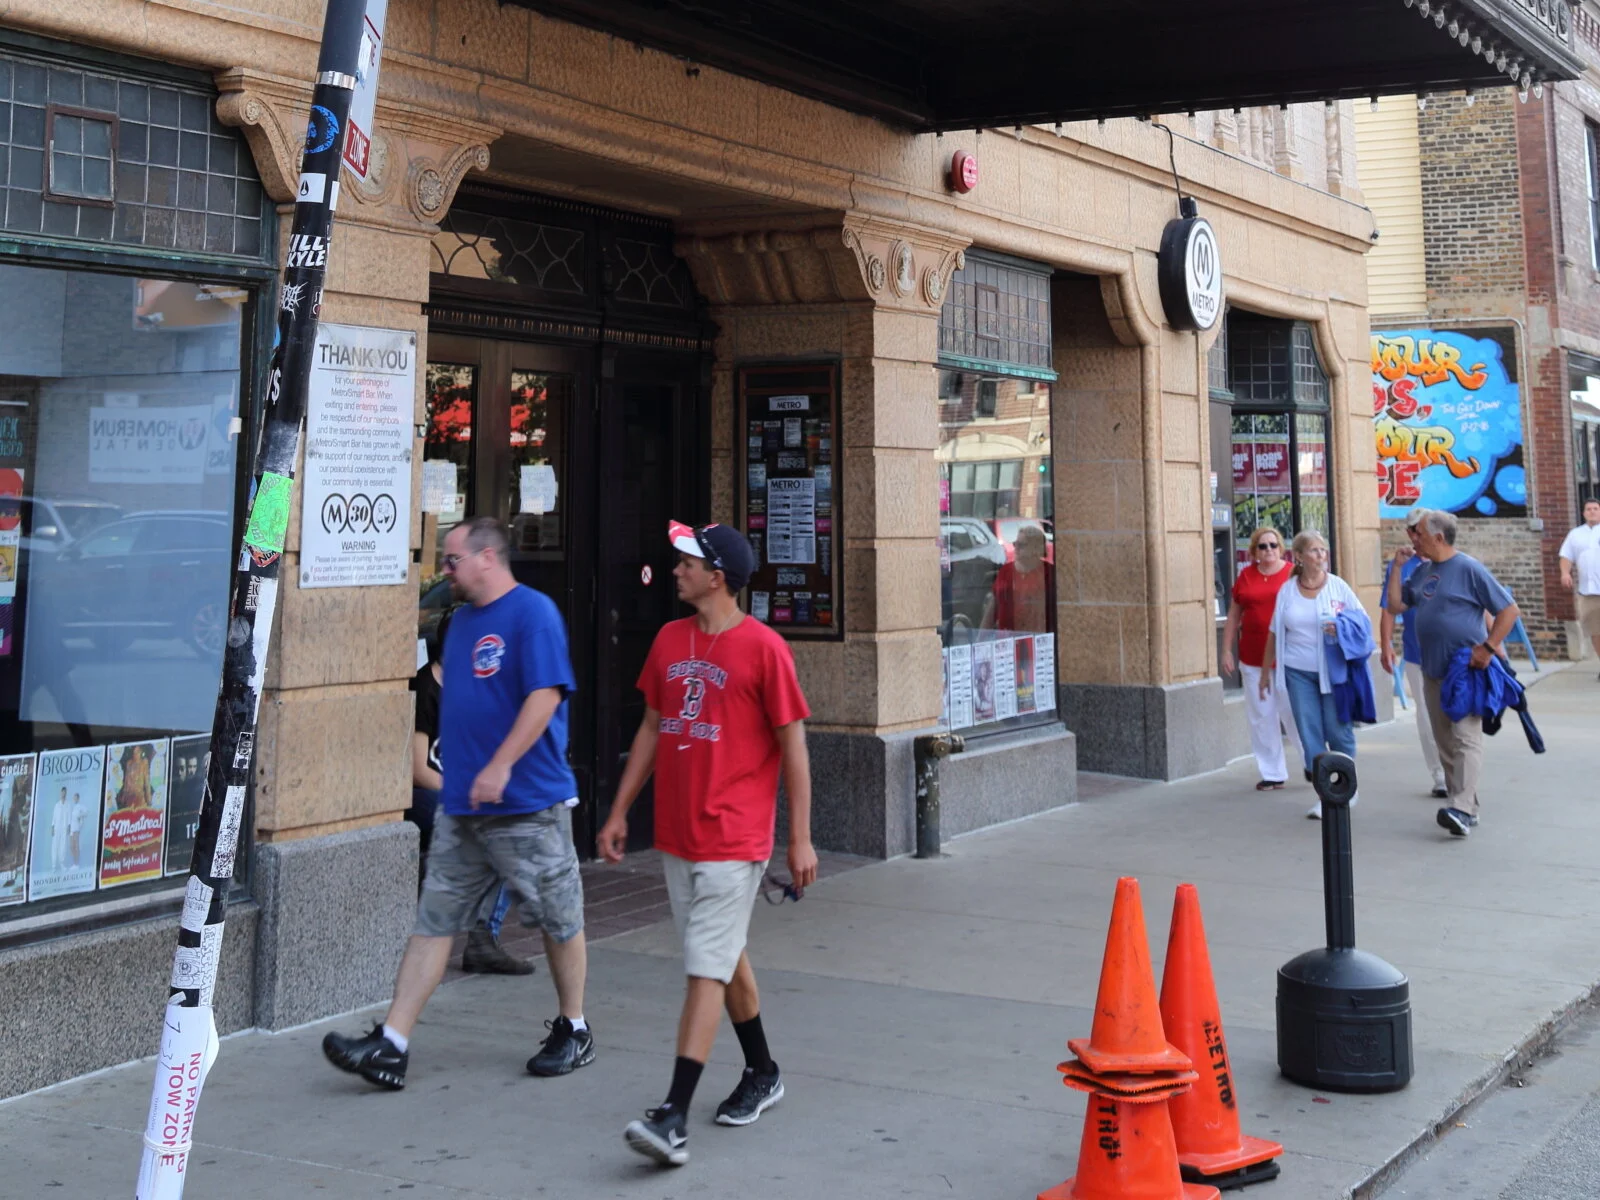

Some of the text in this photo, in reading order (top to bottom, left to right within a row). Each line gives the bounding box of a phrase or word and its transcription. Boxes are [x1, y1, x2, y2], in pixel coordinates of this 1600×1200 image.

[289, 234, 325, 252] ILL
[286, 249, 326, 268] KYLE
[1192, 291, 1215, 313] METRO
[319, 343, 408, 370] THANK YOU
[776, 401, 802, 409] METRO
[770, 479, 800, 489] METRO
[341, 540, 376, 551] WARNING
[666, 660, 728, 690] BOSTON
[679, 677, 706, 720] B
[1, 764, 28, 777] CIRCLES
[41, 752, 101, 777] BROODS
[104, 819, 116, 839] of
[116, 813, 163, 837] Montreal
[188, 1052, 202, 1081] NO
[167, 1063, 185, 1107] TOW
